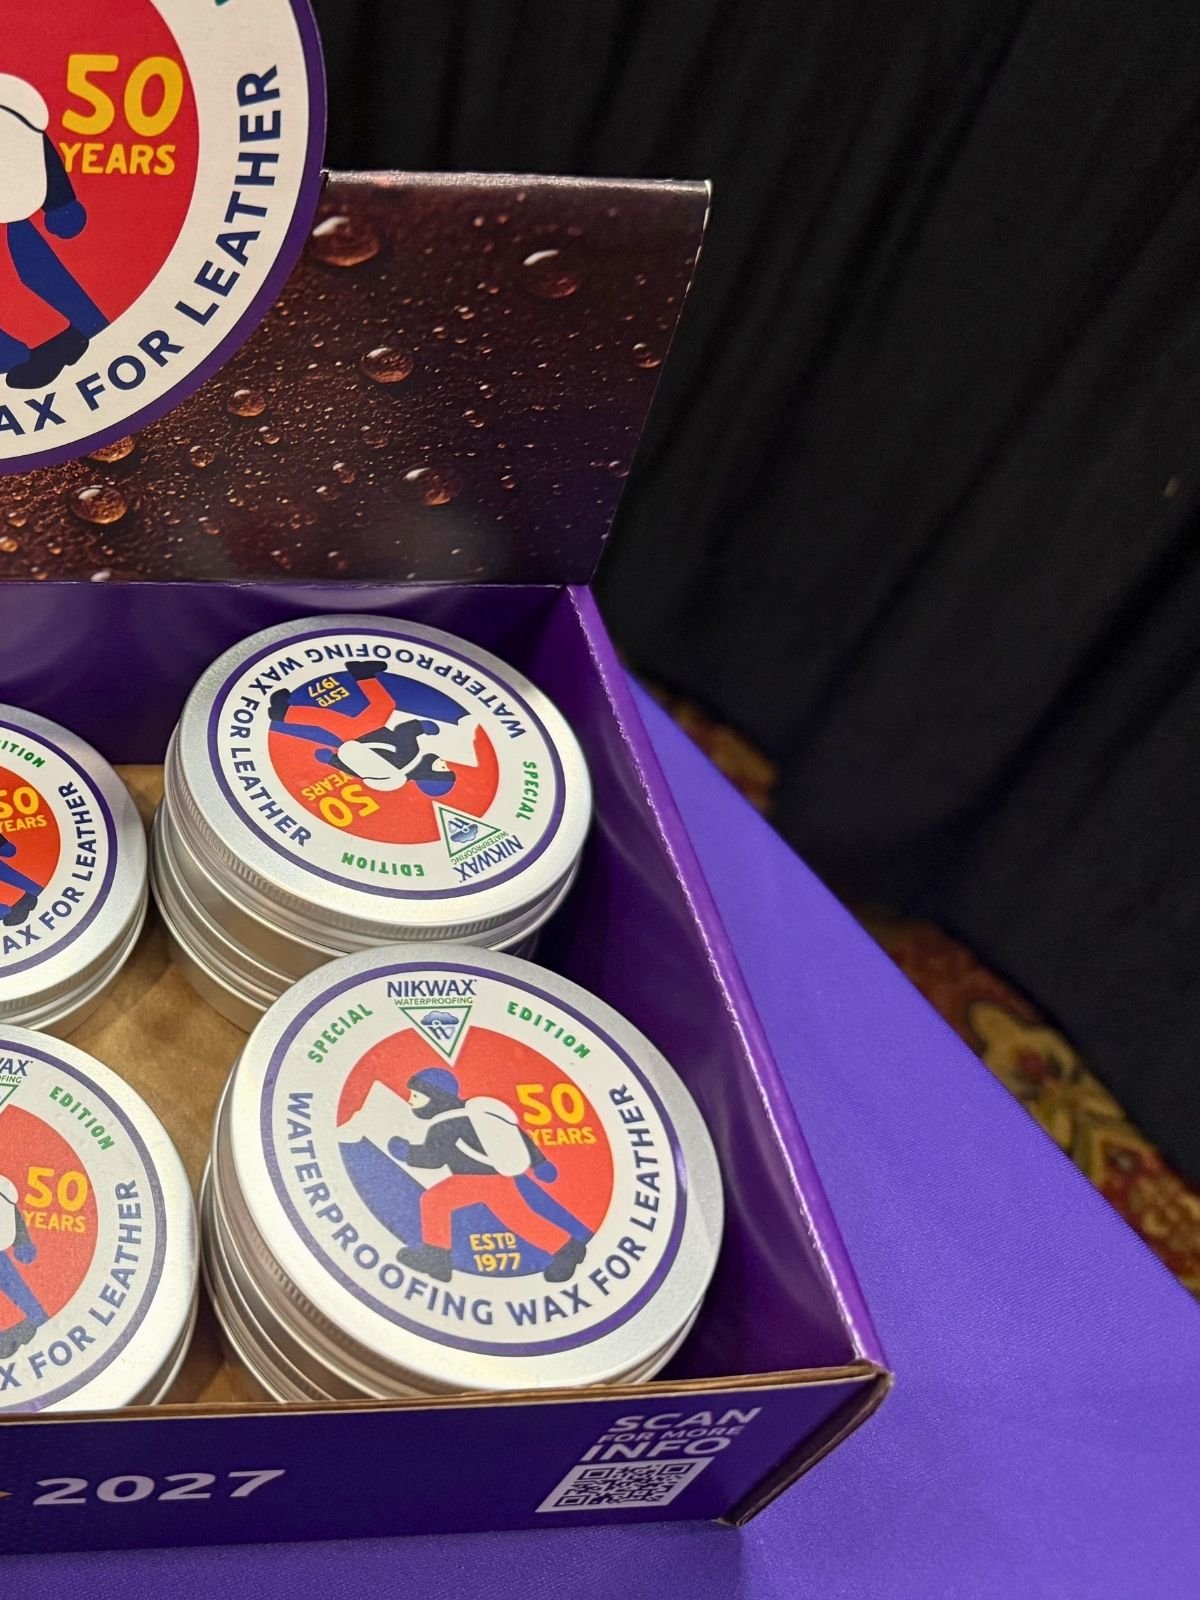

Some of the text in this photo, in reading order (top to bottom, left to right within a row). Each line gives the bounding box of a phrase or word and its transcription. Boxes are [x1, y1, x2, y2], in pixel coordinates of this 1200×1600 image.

[63, 54, 184, 136] 50
[58, 143, 175, 176] YEARS
[75, 329, 183, 413] FOR
[177, 65, 282, 326] LEATHER
[308, 675, 340, 698] 1977
[317, 687, 350, 708] ESTD
[230, 643, 526, 848] WATERPROOFING WAX FOR LEATHER
[302, 771, 365, 803] YEARS
[318, 784, 380, 828] 50
[341, 760, 538, 877] SPECIAL EDITION
[57, 781, 97, 883] LEATHER
[450, 830, 509, 865] WATERPROOFING
[456, 835, 524, 883] NIKWAX
[38, 886, 85, 933] FOR
[387, 979, 476, 999] NIKWAX
[394, 997, 473, 1006] WATERPROOFING
[307, 1001, 590, 1063] SPECIAL EDITION
[49, 1085, 115, 1151] EDITION
[515, 1083, 585, 1126] 50
[527, 1126, 597, 1146] YEARS
[24, 1167, 88, 1211] 50
[287, 1084, 661, 1326] WATERPROOFING WAX FOR LEATHER
[22, 1211, 85, 1233] YEARS
[469, 1234, 517, 1251] ESTD
[29, 1325, 96, 1379] FOR
[89, 1179, 142, 1327] LEATHER
[474, 1253, 521, 1271] 1977
[597, 1425, 745, 1443] FOR MORE
[608, 1407, 763, 1432] SCAN
[580, 1437, 731, 1461] INFO
[32, 1469, 286, 1506] 2027
